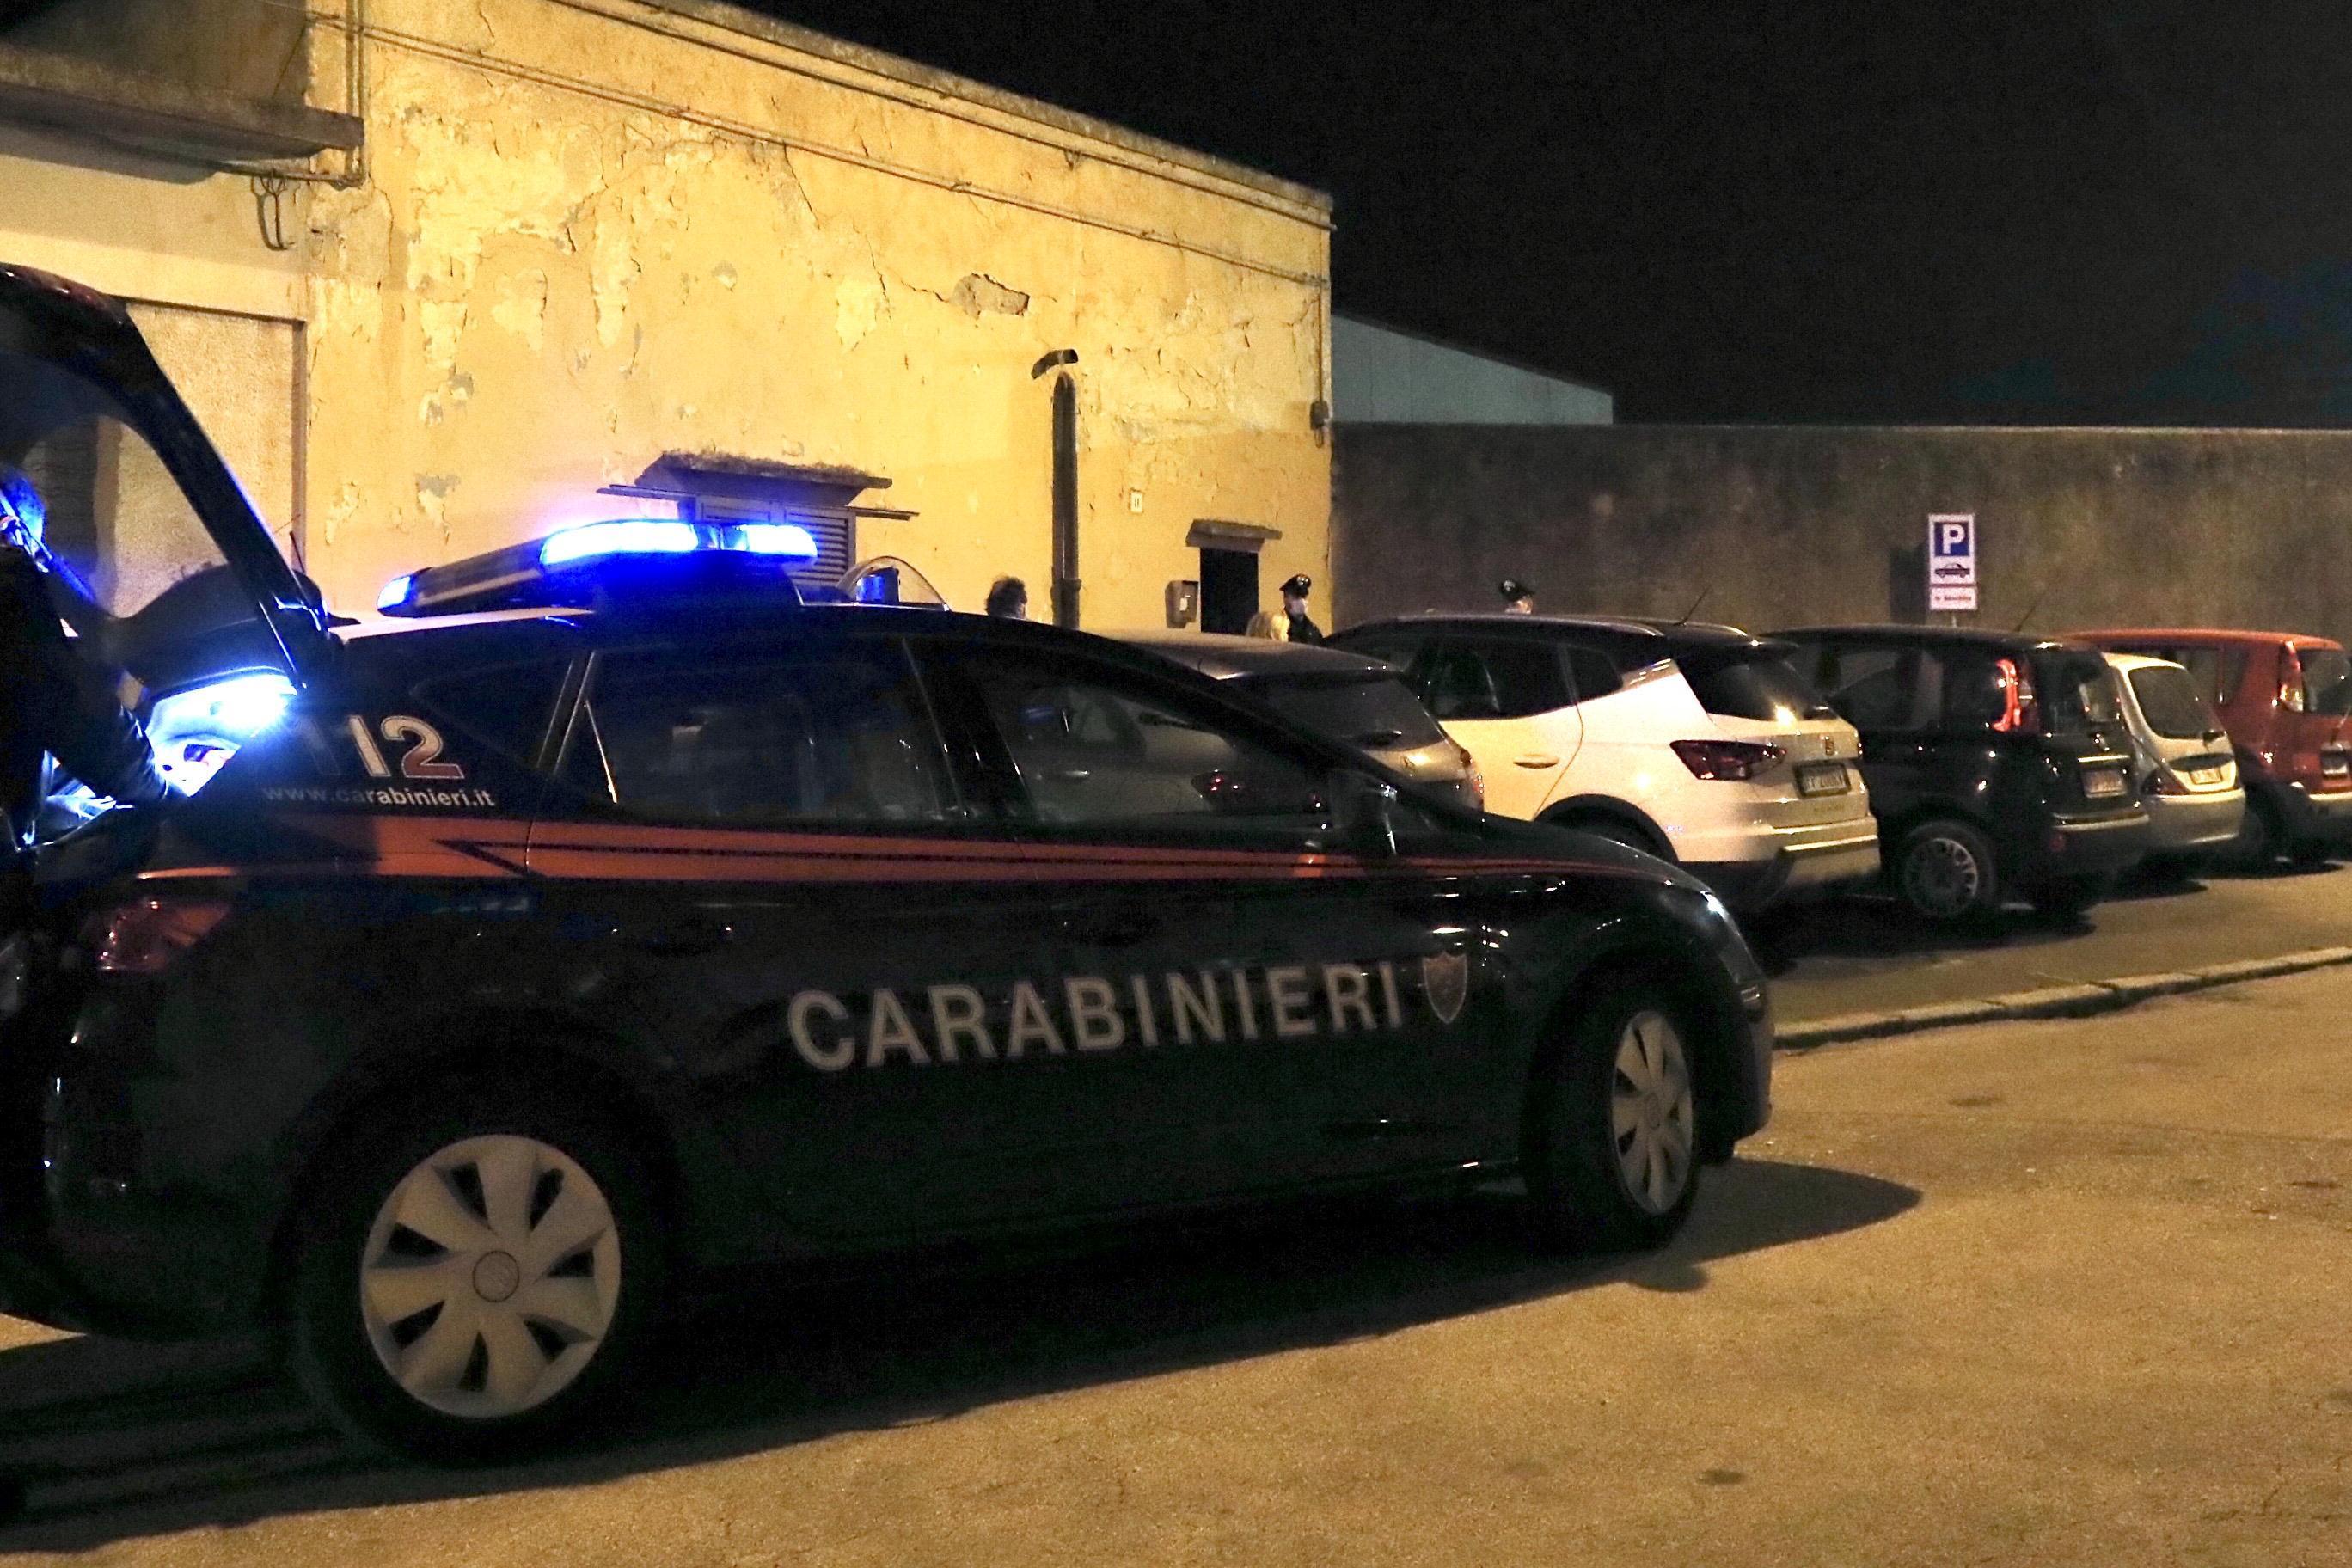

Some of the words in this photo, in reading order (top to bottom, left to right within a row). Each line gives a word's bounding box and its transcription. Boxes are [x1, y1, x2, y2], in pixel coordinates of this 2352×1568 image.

[1943, 524, 1966, 554] P
[262, 787, 496, 807] www.carabinieri.it
[787, 961, 1403, 1072] CARABINIERI
